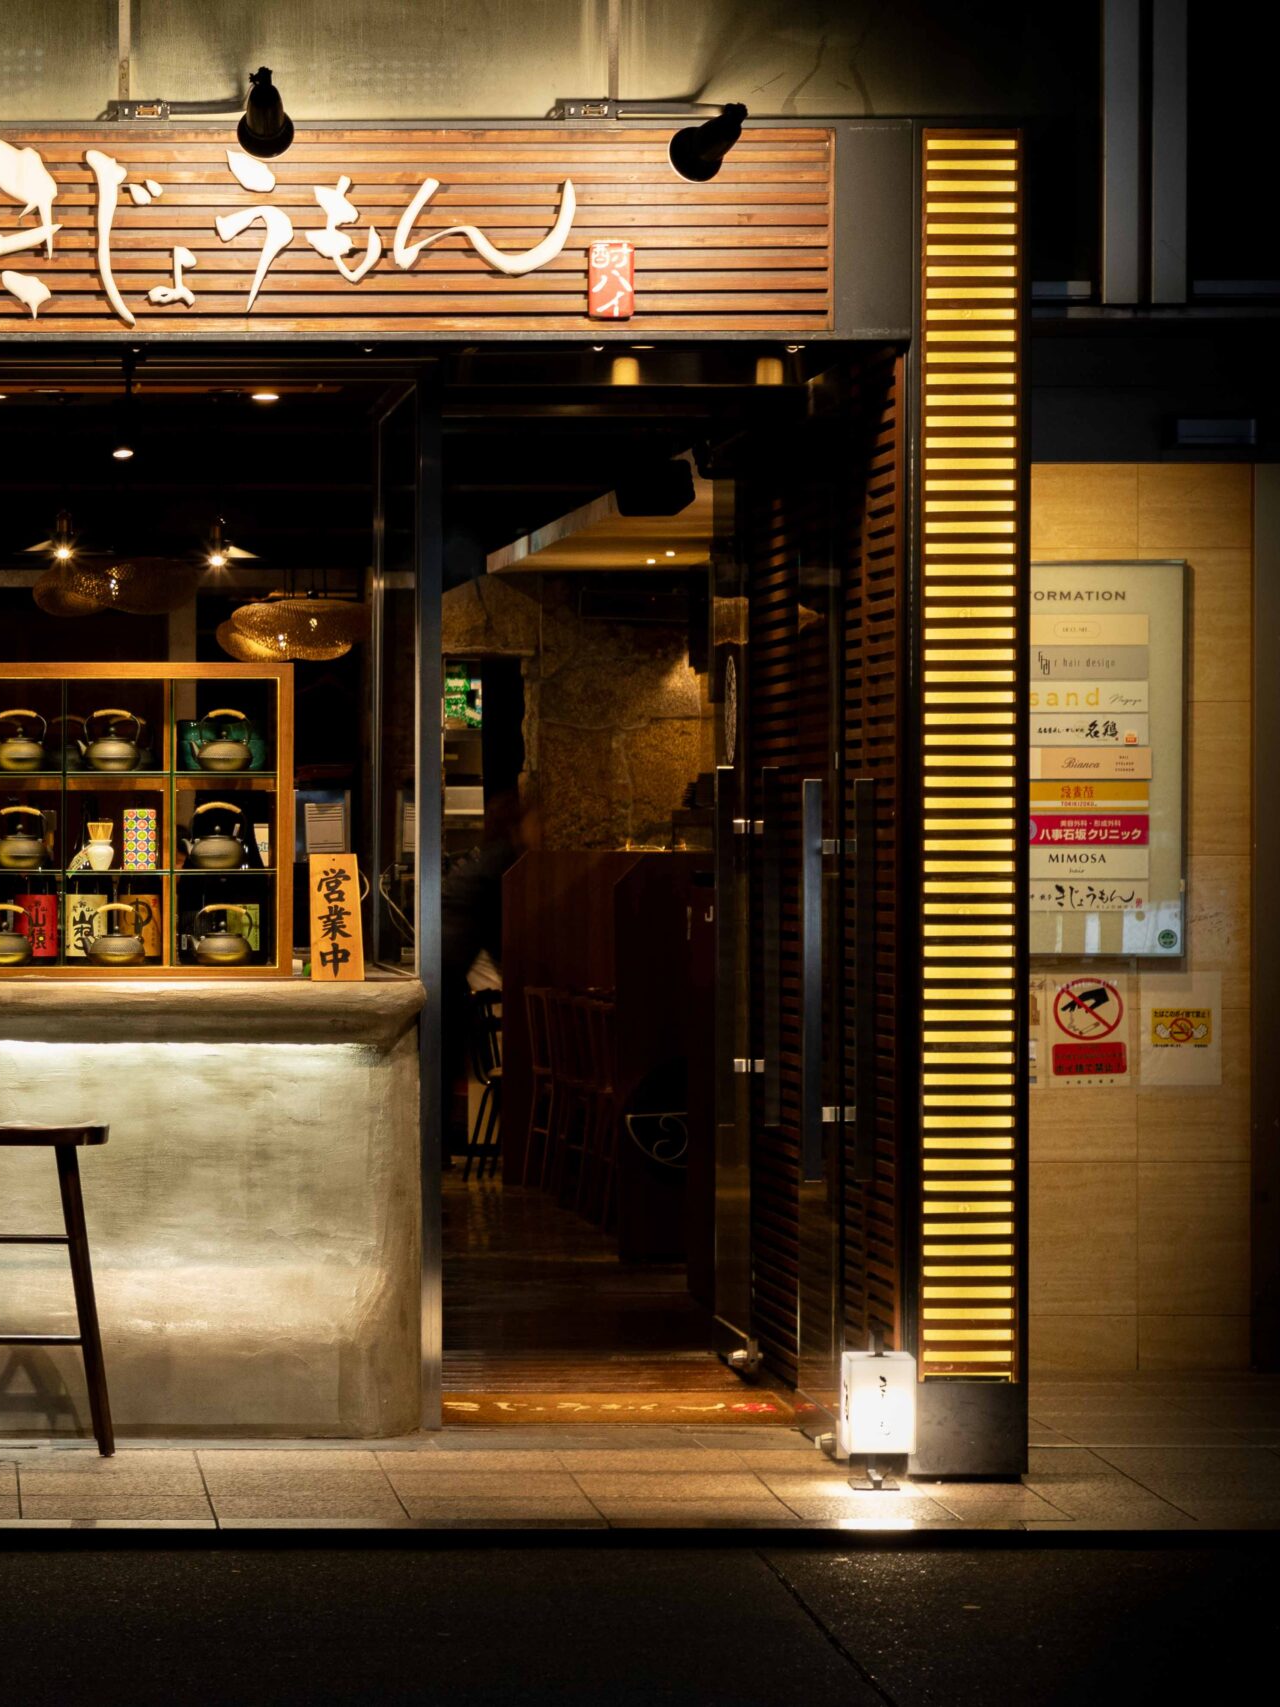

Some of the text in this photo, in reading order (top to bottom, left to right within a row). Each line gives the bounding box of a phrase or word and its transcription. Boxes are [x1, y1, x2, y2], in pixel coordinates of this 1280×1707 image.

[1029, 590, 1127, 601] ORMATION
[1061, 757, 1100, 769] Bianca
[1039, 828, 1142, 841] 八事石坂クリニック
[1048, 853, 1107, 864] MIMOSA
[1054, 884, 1135, 909] きじょうもん
[317, 868, 352, 978] 営業中
